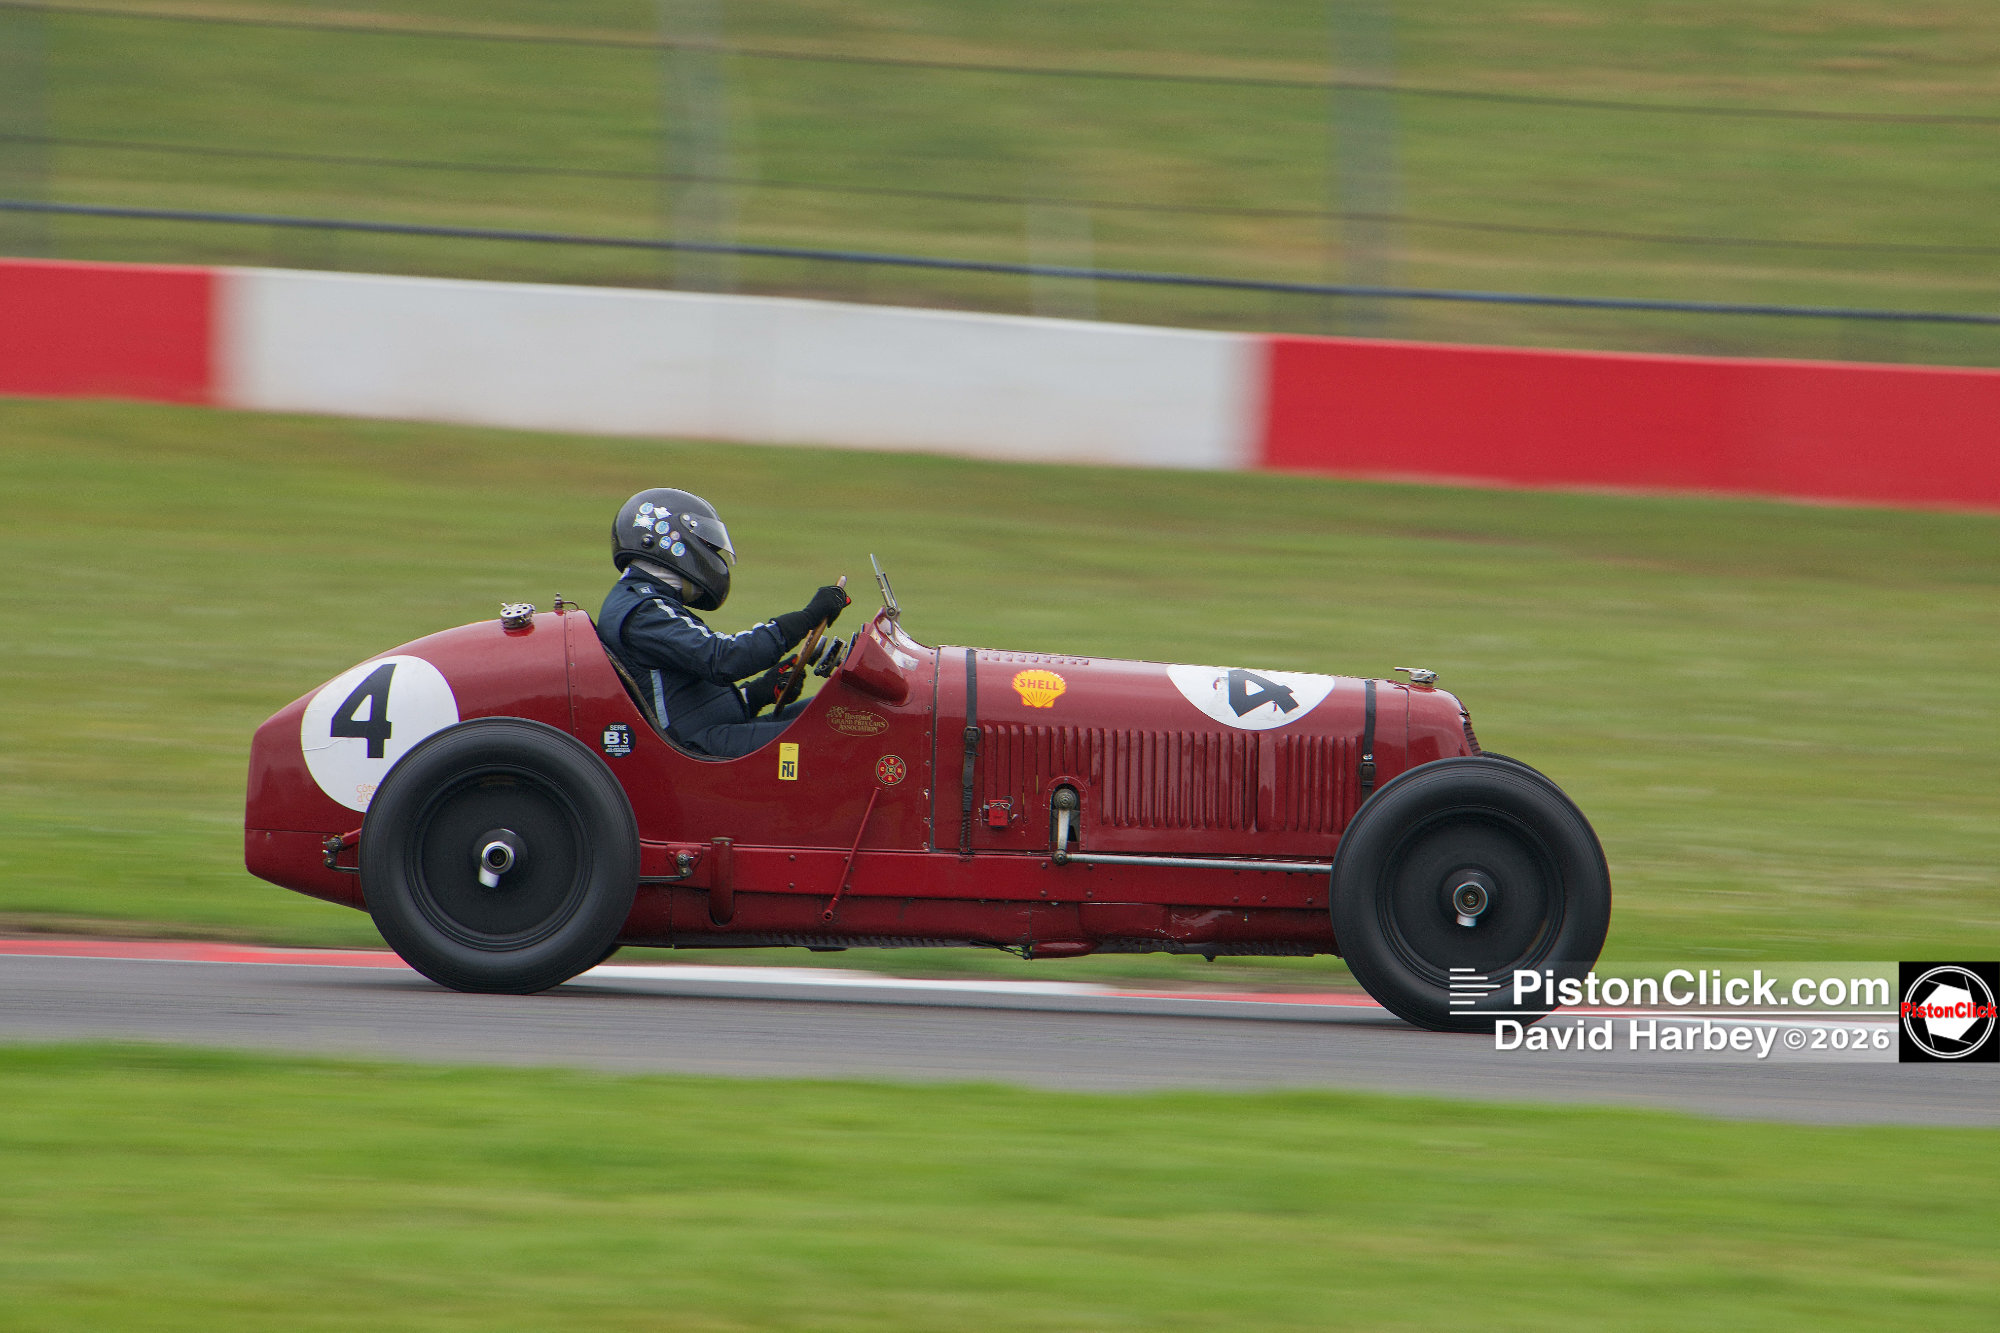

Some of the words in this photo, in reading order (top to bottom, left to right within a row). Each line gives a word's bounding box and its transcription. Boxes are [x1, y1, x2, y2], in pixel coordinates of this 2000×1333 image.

[1019, 678, 1060, 691] SHELL
[1228, 669, 1299, 718] 4
[329, 663, 397, 758] 4
[603, 731, 620, 745] B
[622, 732, 629, 745] 5
